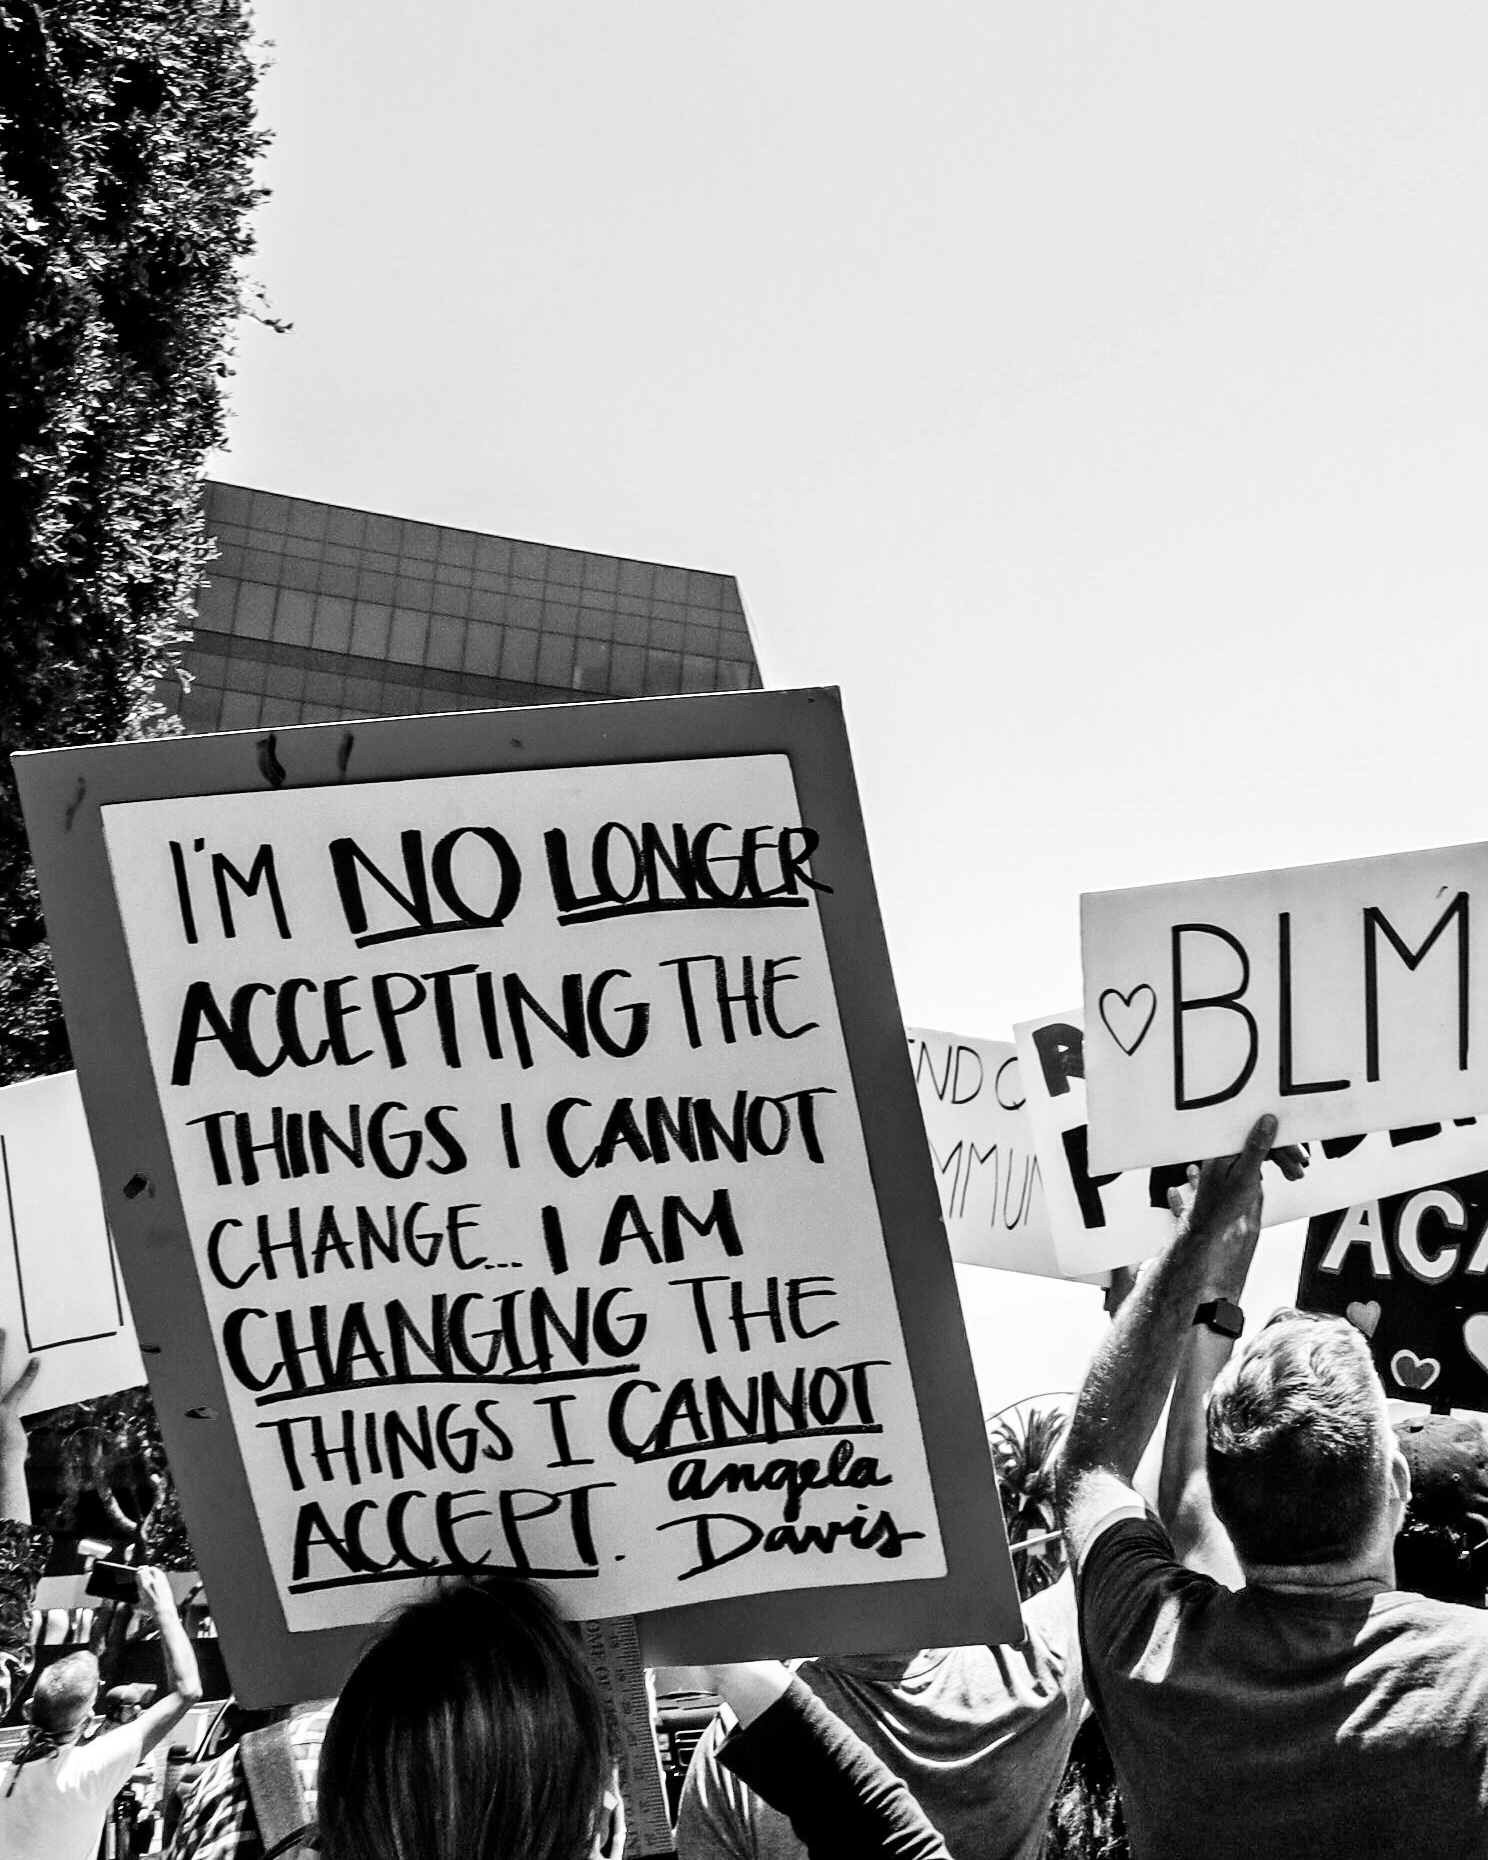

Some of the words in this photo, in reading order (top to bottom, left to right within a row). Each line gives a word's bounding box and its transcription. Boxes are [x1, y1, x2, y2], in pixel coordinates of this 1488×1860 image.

[169, 838, 292, 944] I'M
[329, 826, 522, 935] NO
[545, 821, 833, 911] LONGER
[171, 963, 651, 1086] ACCEPTING
[659, 955, 820, 1048] THE
[1171, 891, 1470, 1111] BLM
[907, 1039, 984, 1102] ND
[186, 1101, 468, 1186] THINGS
[500, 1102, 521, 1169] I
[546, 1087, 838, 1178] CANNOT
[541, 1205, 570, 1275] I
[599, 1189, 743, 1266] AM
[222, 1286, 648, 1391] CHANGING
[668, 1275, 841, 1354] THE
[256, 1399, 514, 1491] THINGS
[534, 1395, 594, 1469] I
[607, 1360, 892, 1460] CANNOT
[656, 1503, 926, 1581] Davis
